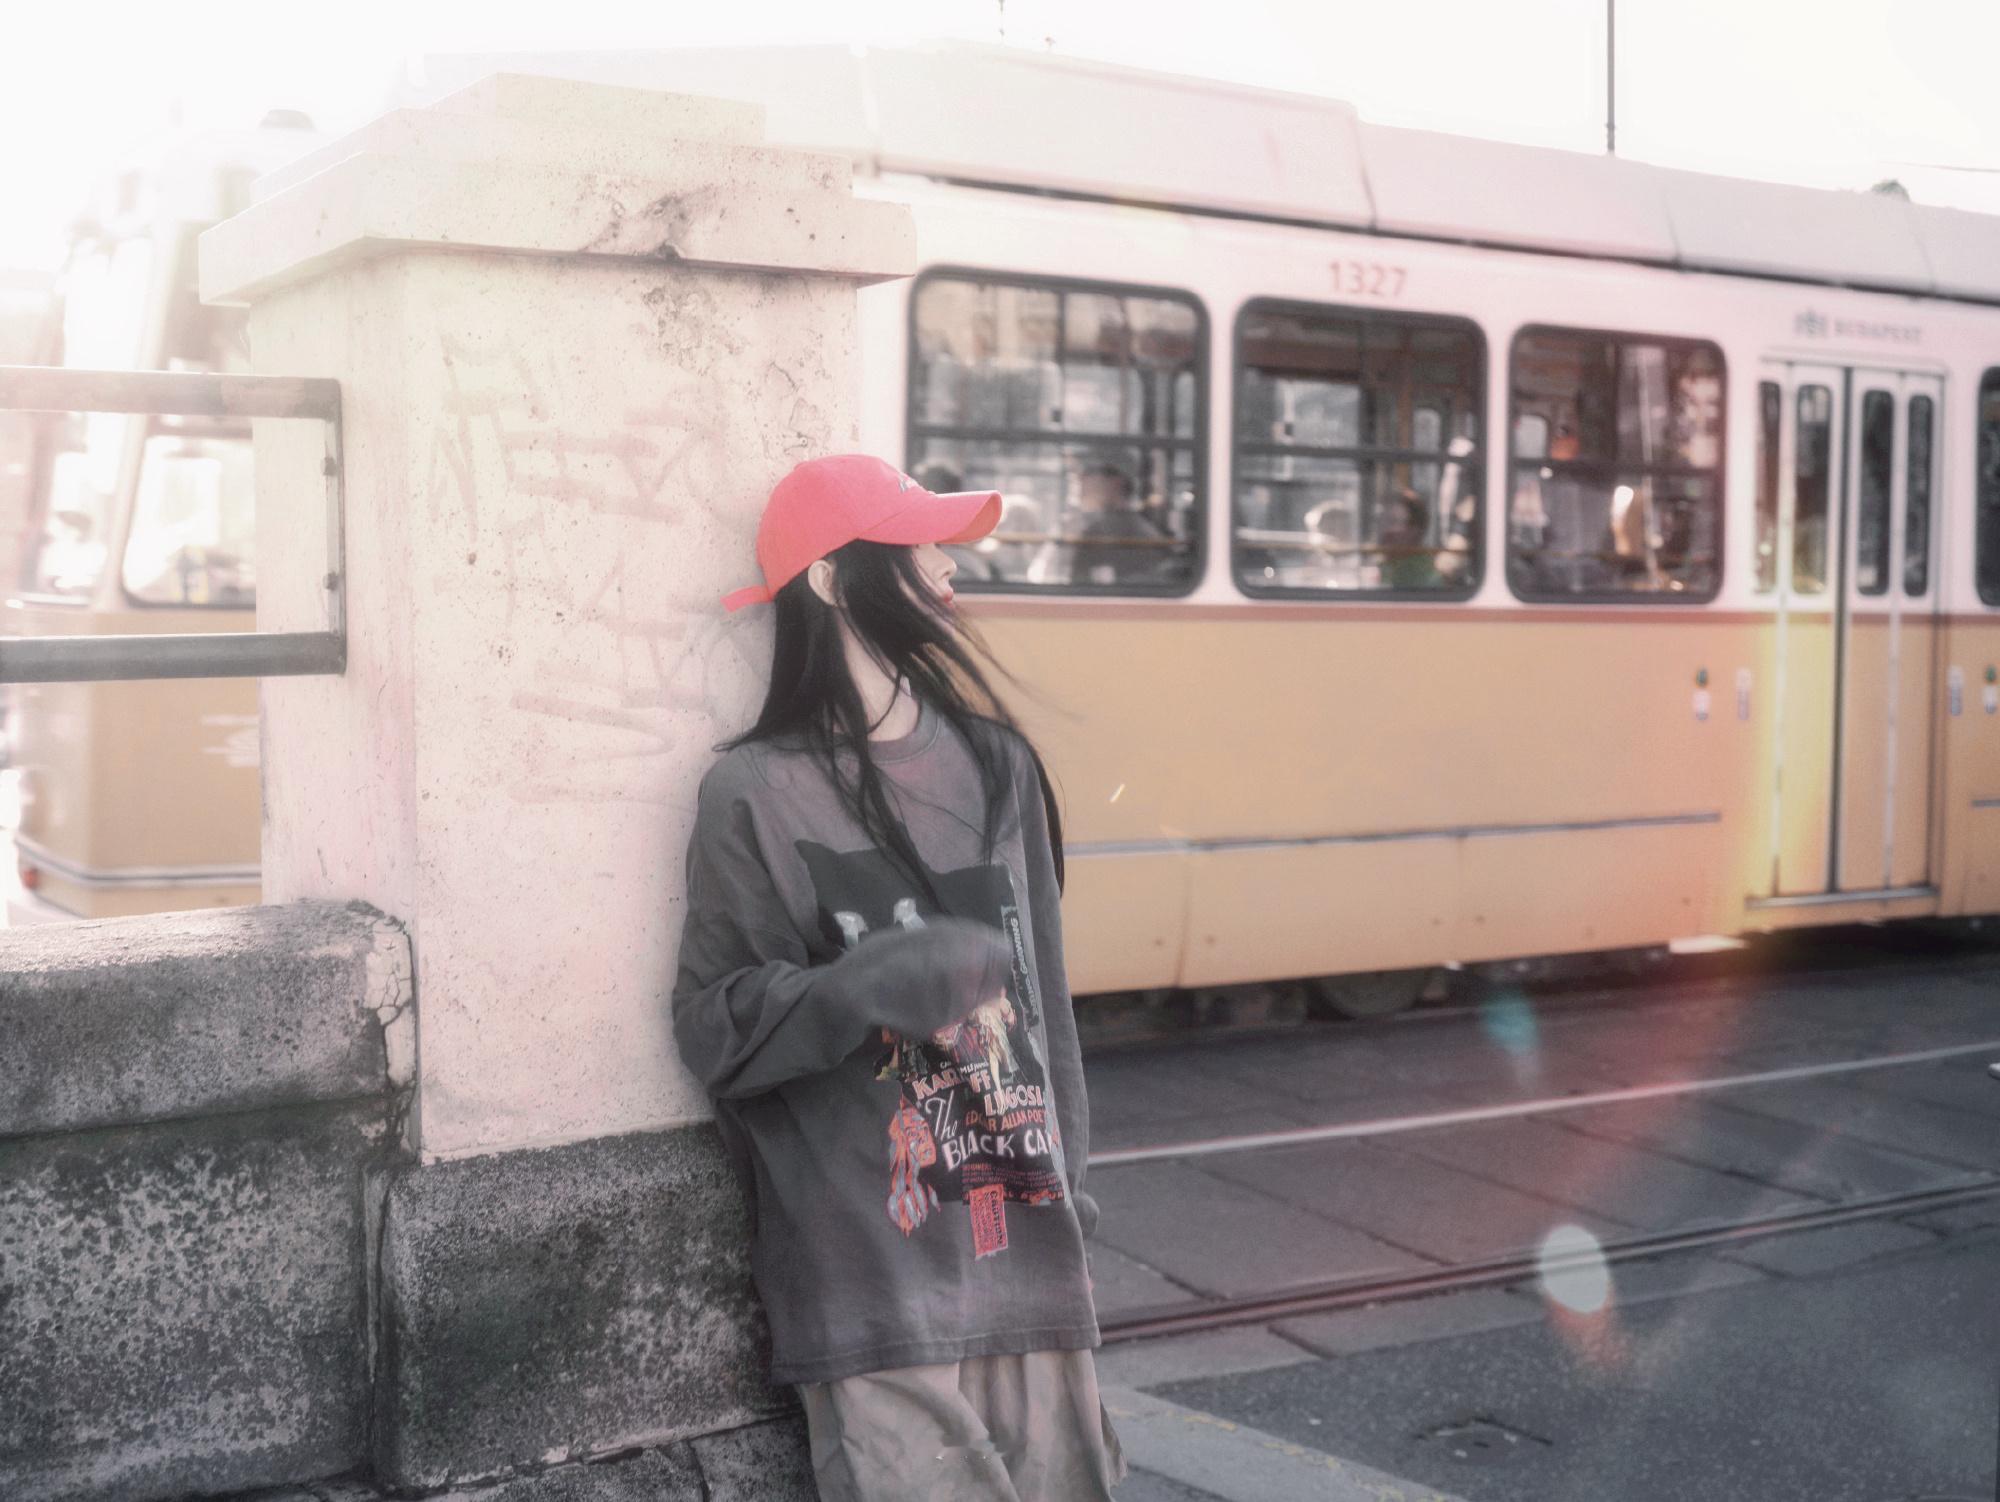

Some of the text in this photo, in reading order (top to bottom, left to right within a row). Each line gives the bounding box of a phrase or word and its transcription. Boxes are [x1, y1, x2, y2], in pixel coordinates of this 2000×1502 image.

[1329, 260, 1408, 297] 1327
[924, 1090, 958, 1140] The
[942, 1130, 1015, 1173] BLACK
